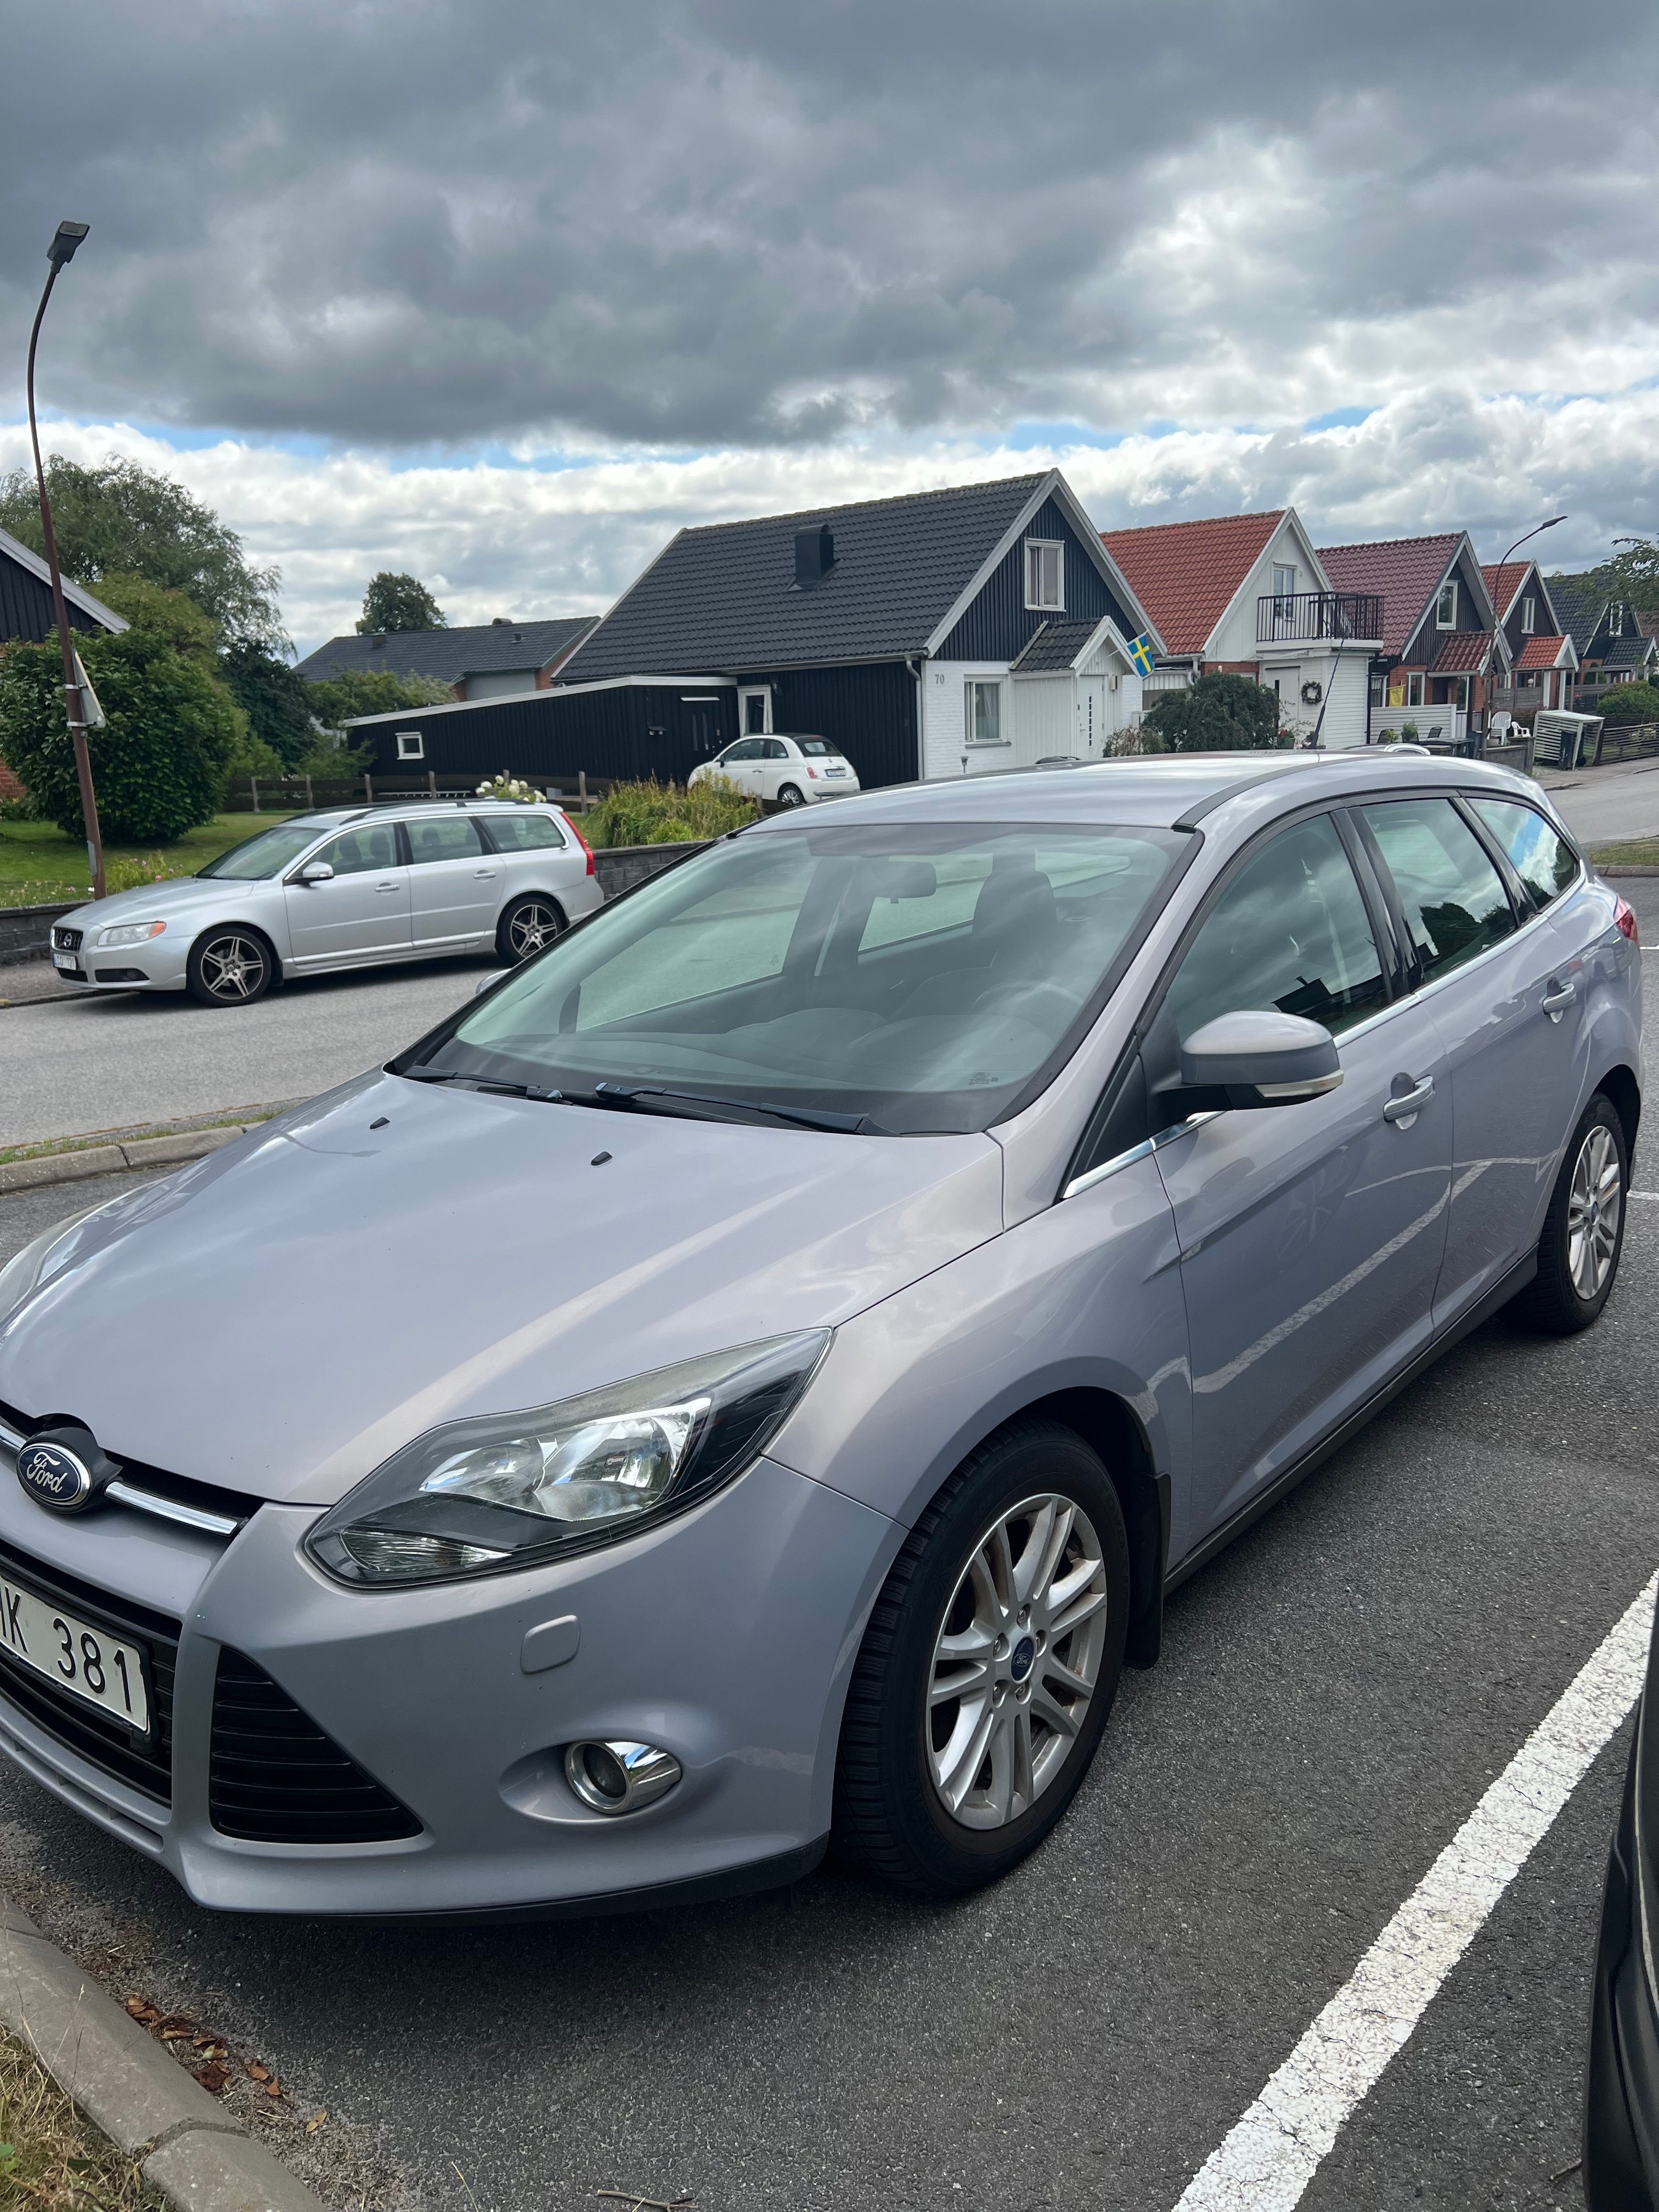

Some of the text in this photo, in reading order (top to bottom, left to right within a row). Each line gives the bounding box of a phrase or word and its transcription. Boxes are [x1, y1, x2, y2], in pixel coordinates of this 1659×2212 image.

[935, 674, 944, 685] 70
[27, 1452, 68, 1493] Ford
[53, 1617, 132, 1713] 381
[1017, 1655, 1029, 1665] Ford
